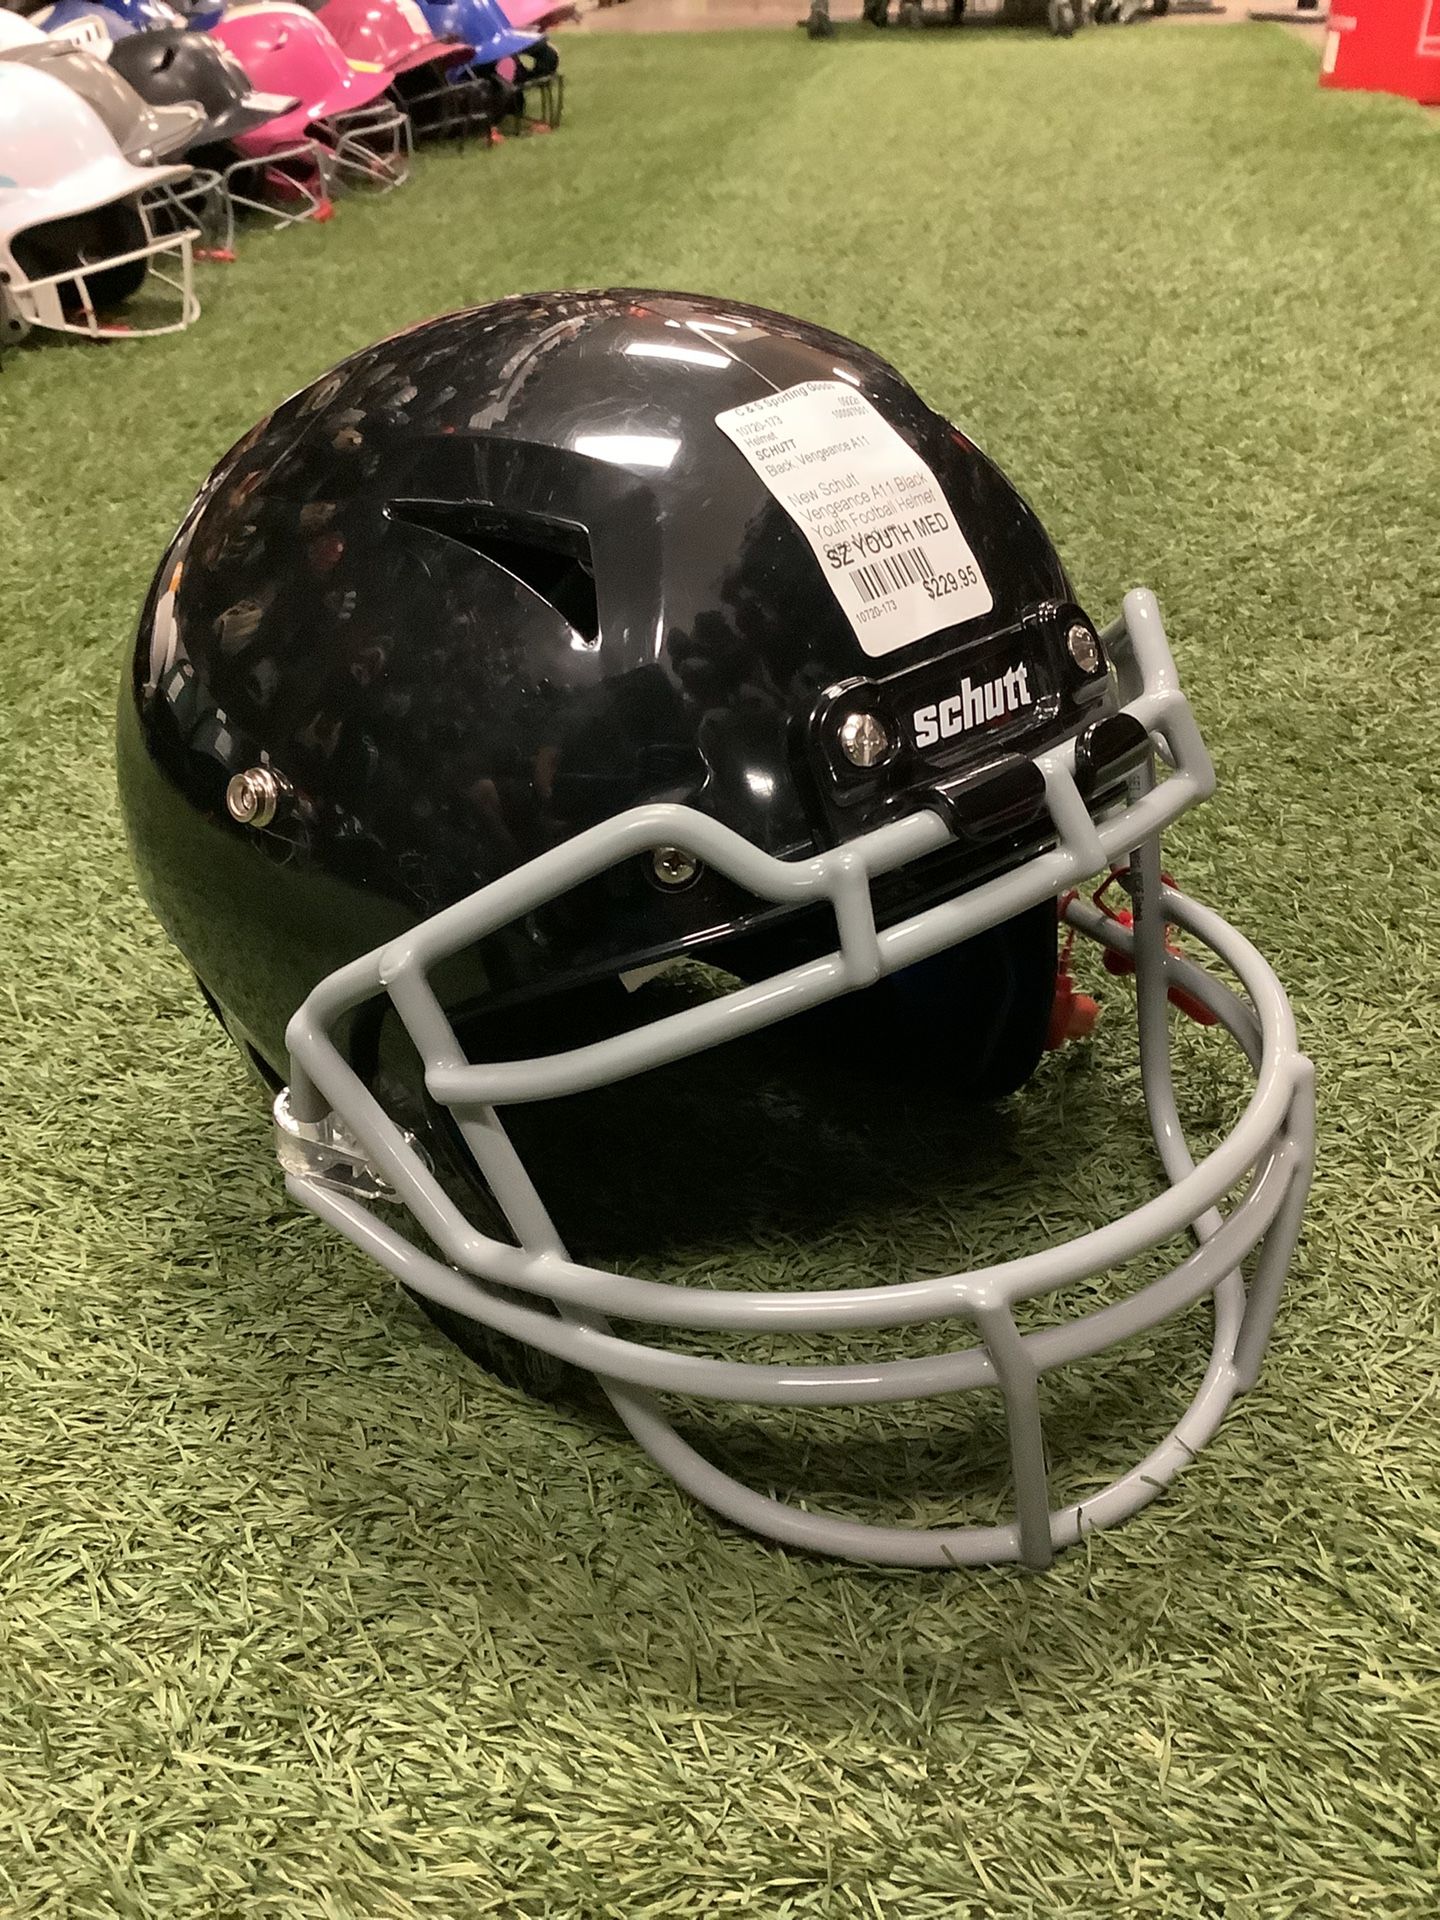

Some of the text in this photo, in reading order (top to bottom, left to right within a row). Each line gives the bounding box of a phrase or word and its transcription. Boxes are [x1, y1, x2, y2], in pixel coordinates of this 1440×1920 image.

[734, 408, 745, 417] C
[745, 405, 755, 414] &
[763, 386, 809, 408] Sporting
[735, 415, 783, 437] 10720-173
[743, 431, 779, 449] Helmet
[755, 438, 797, 461] SCHUTT
[794, 440, 852, 466] Vengeance
[850, 435, 871, 450] A11
[787, 472, 860, 508] New Schutt
[799, 471, 928, 523] Vengeance A11 Black
[811, 488, 937, 540] Youth Football Helmet
[826, 512, 949, 569] SZ YOUTH MED
[922, 565, 978, 600] $229.95
[856, 599, 898, 625] 10720-173
[913, 661, 1032, 749] schutt
